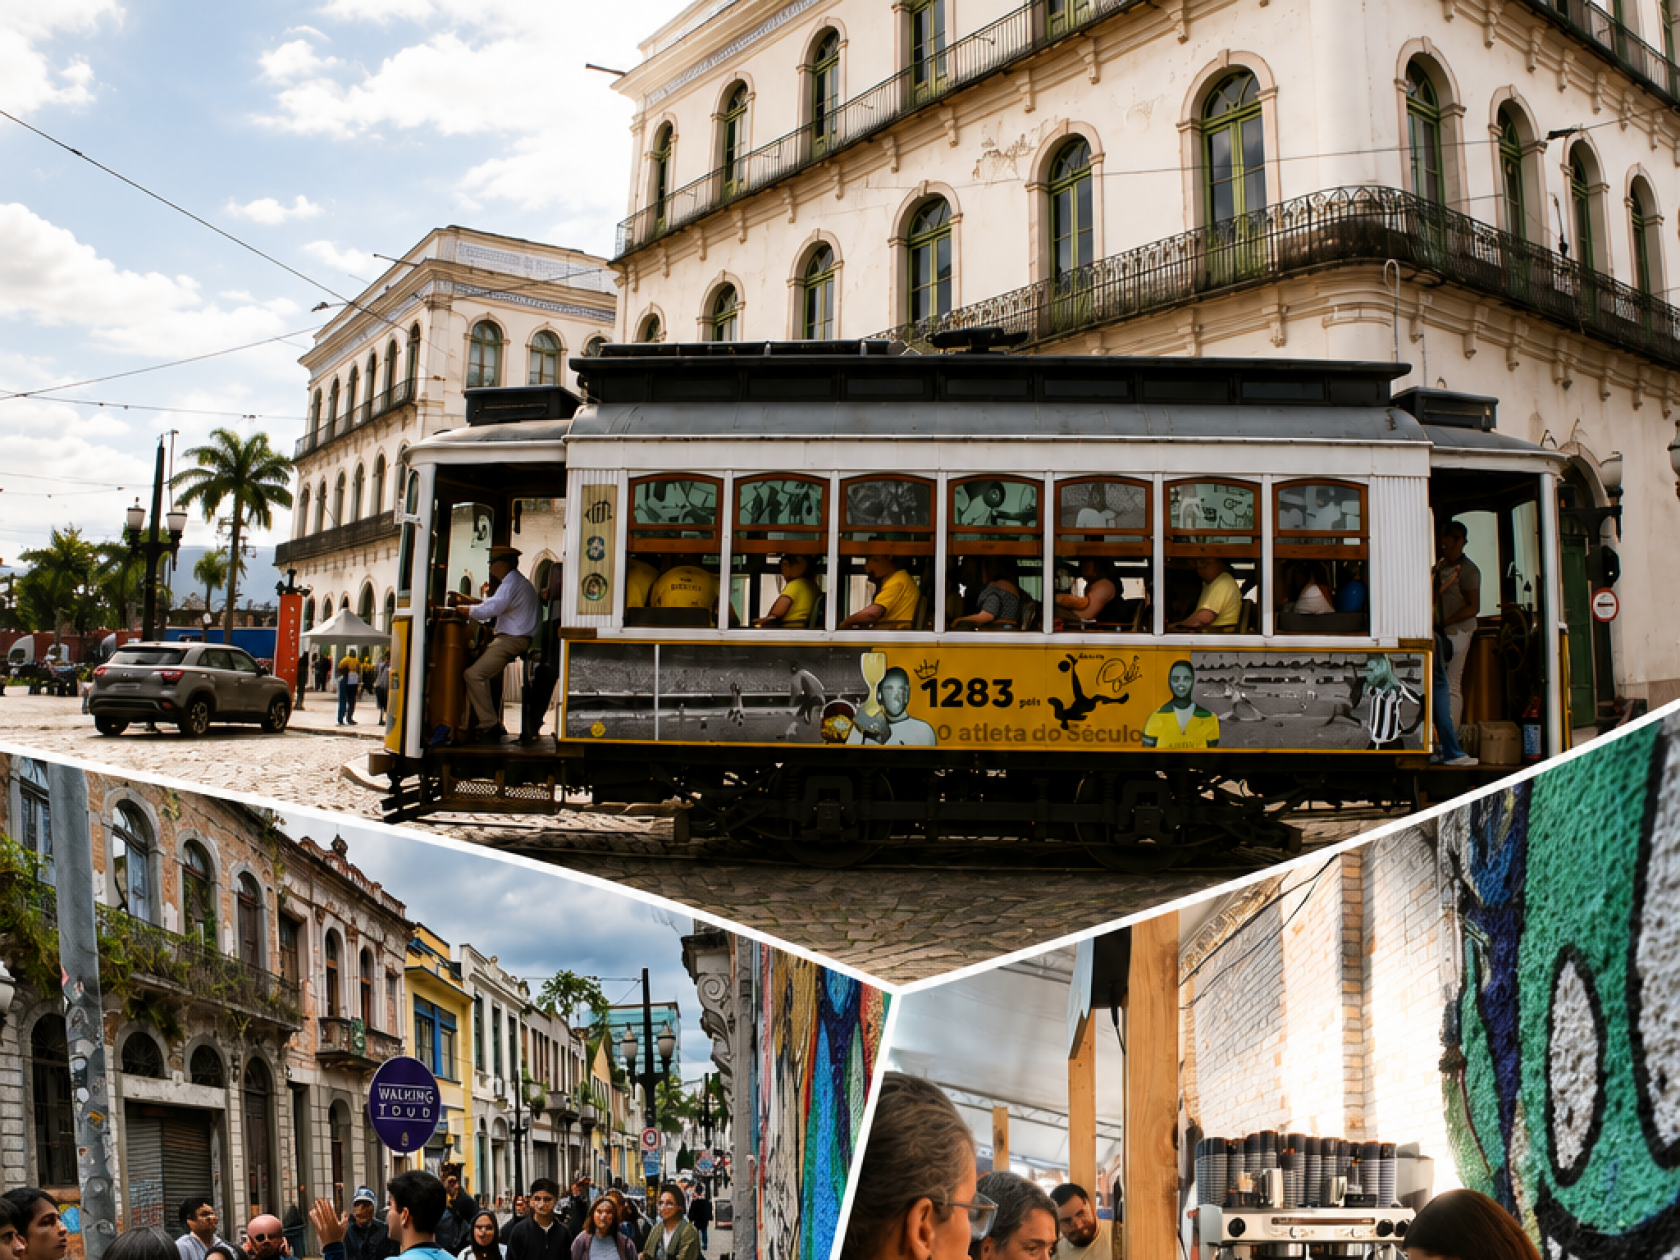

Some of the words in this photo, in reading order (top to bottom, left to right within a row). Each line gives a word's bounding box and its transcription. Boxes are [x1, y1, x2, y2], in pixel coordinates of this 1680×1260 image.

[921, 677, 1014, 708] 1283
[937, 724, 952, 741] O
[958, 722, 1027, 742] atleta
[1032, 723, 1062, 742] do
[1067, 723, 1143, 742] Século
[378, 1087, 434, 1104] WALKING
